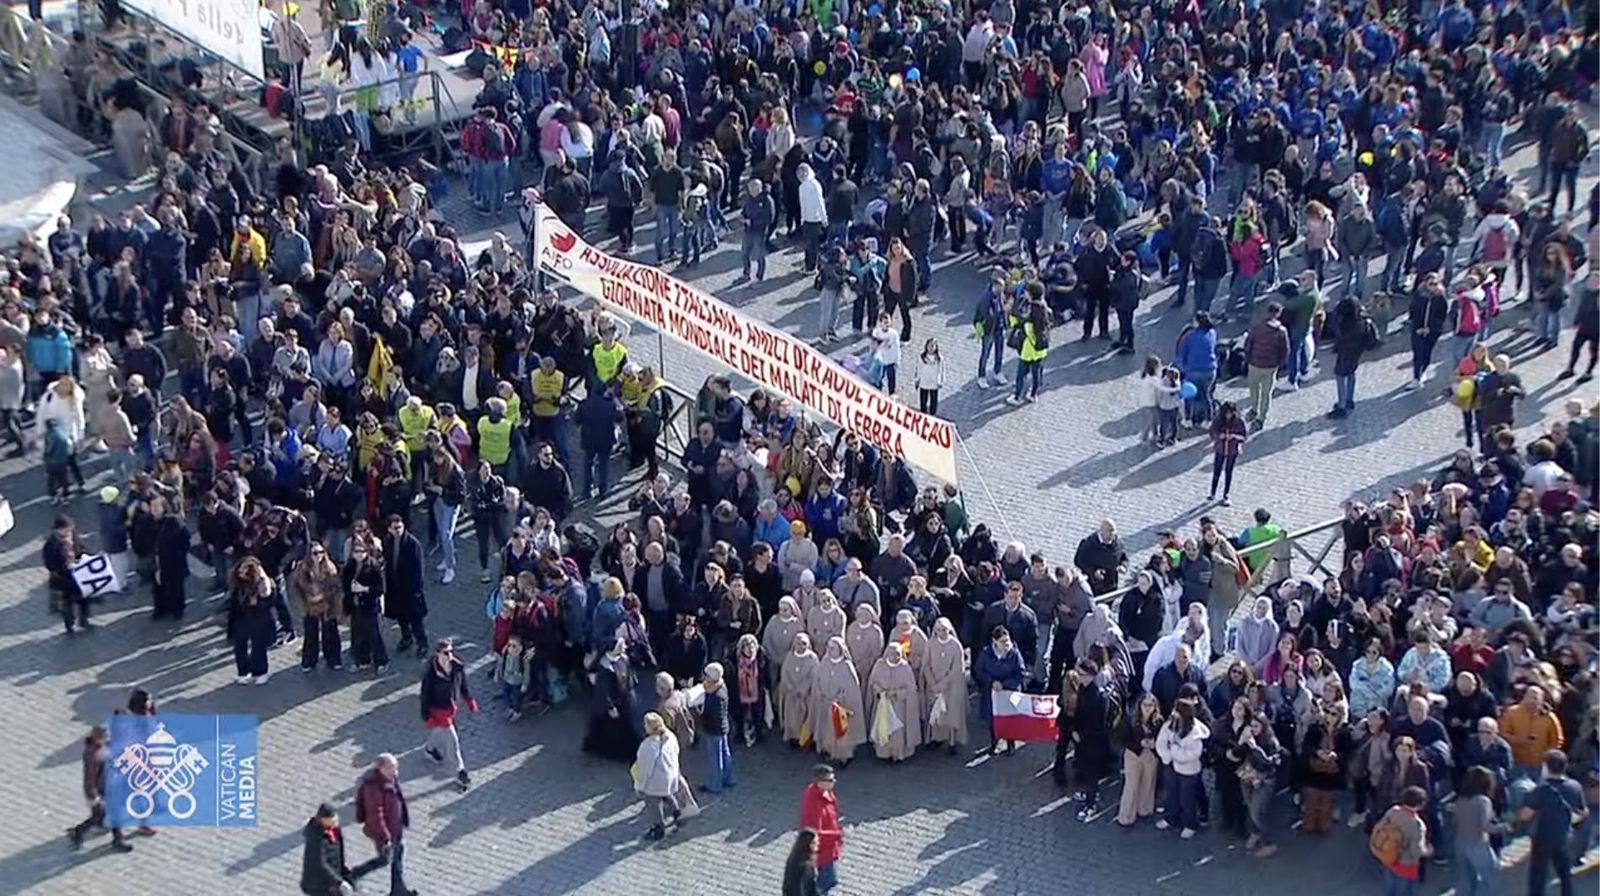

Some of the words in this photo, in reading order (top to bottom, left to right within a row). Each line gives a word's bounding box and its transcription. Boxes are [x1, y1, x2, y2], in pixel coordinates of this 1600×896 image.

[541, 246, 573, 270] AIFO
[600, 277, 667, 331] GIORNATA
[669, 311, 739, 369] MONDIALE
[740, 349, 768, 383] DEI
[769, 364, 824, 414] MALATI
[827, 395, 844, 425] DI
[846, 405, 907, 460] LEBBRA
[674, 282, 742, 340] ITALIANA
[746, 322, 789, 365] AMICI
[793, 345, 809, 375] DI
